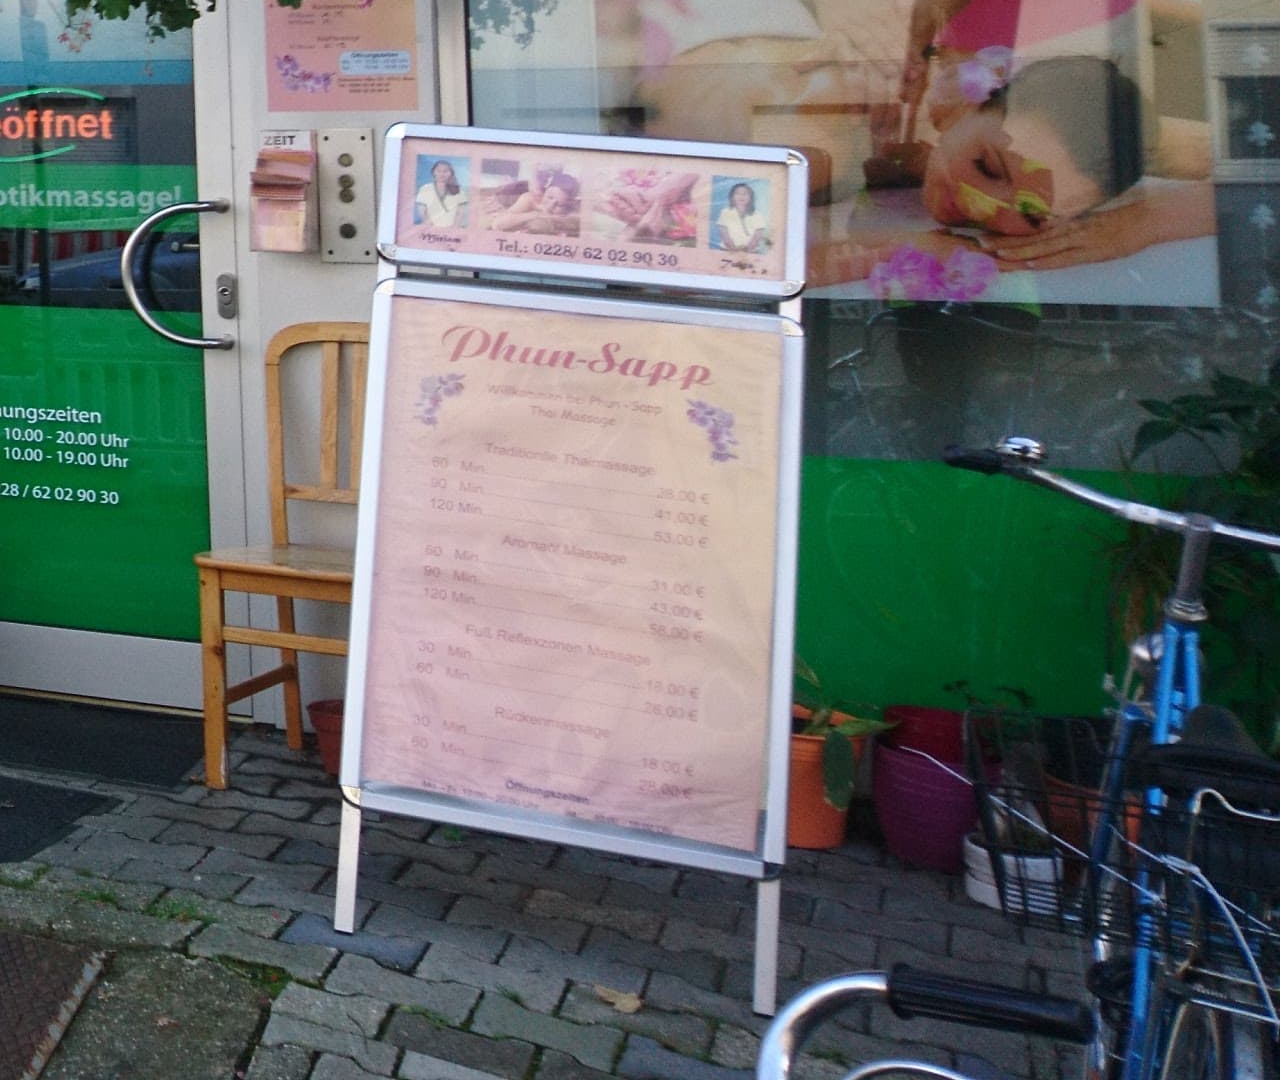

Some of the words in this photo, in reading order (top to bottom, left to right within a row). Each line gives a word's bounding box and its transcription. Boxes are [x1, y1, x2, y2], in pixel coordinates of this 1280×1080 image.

[496, 239, 528, 255] Tel.:
[583, 247, 603, 262] 62
[607, 249, 627, 264] 02
[631, 251, 652, 266] 90
[658, 253, 678, 268] 30
[441, 325, 715, 391] Phun-Sapp
[4, 427, 43, 443] 10.00
[56, 430, 97, 447] 20.00
[100, 432, 130, 449] Uhr
[4, 447, 43, 462] 10.00
[56, 450, 97, 466] 19.00
[100, 452, 129, 468] Uhr
[33, 484, 53, 499] 62
[55, 485, 76, 501] 02
[78, 487, 98, 503] 90
[100, 489, 119, 505] 30
[430, 498, 454, 511] 120
